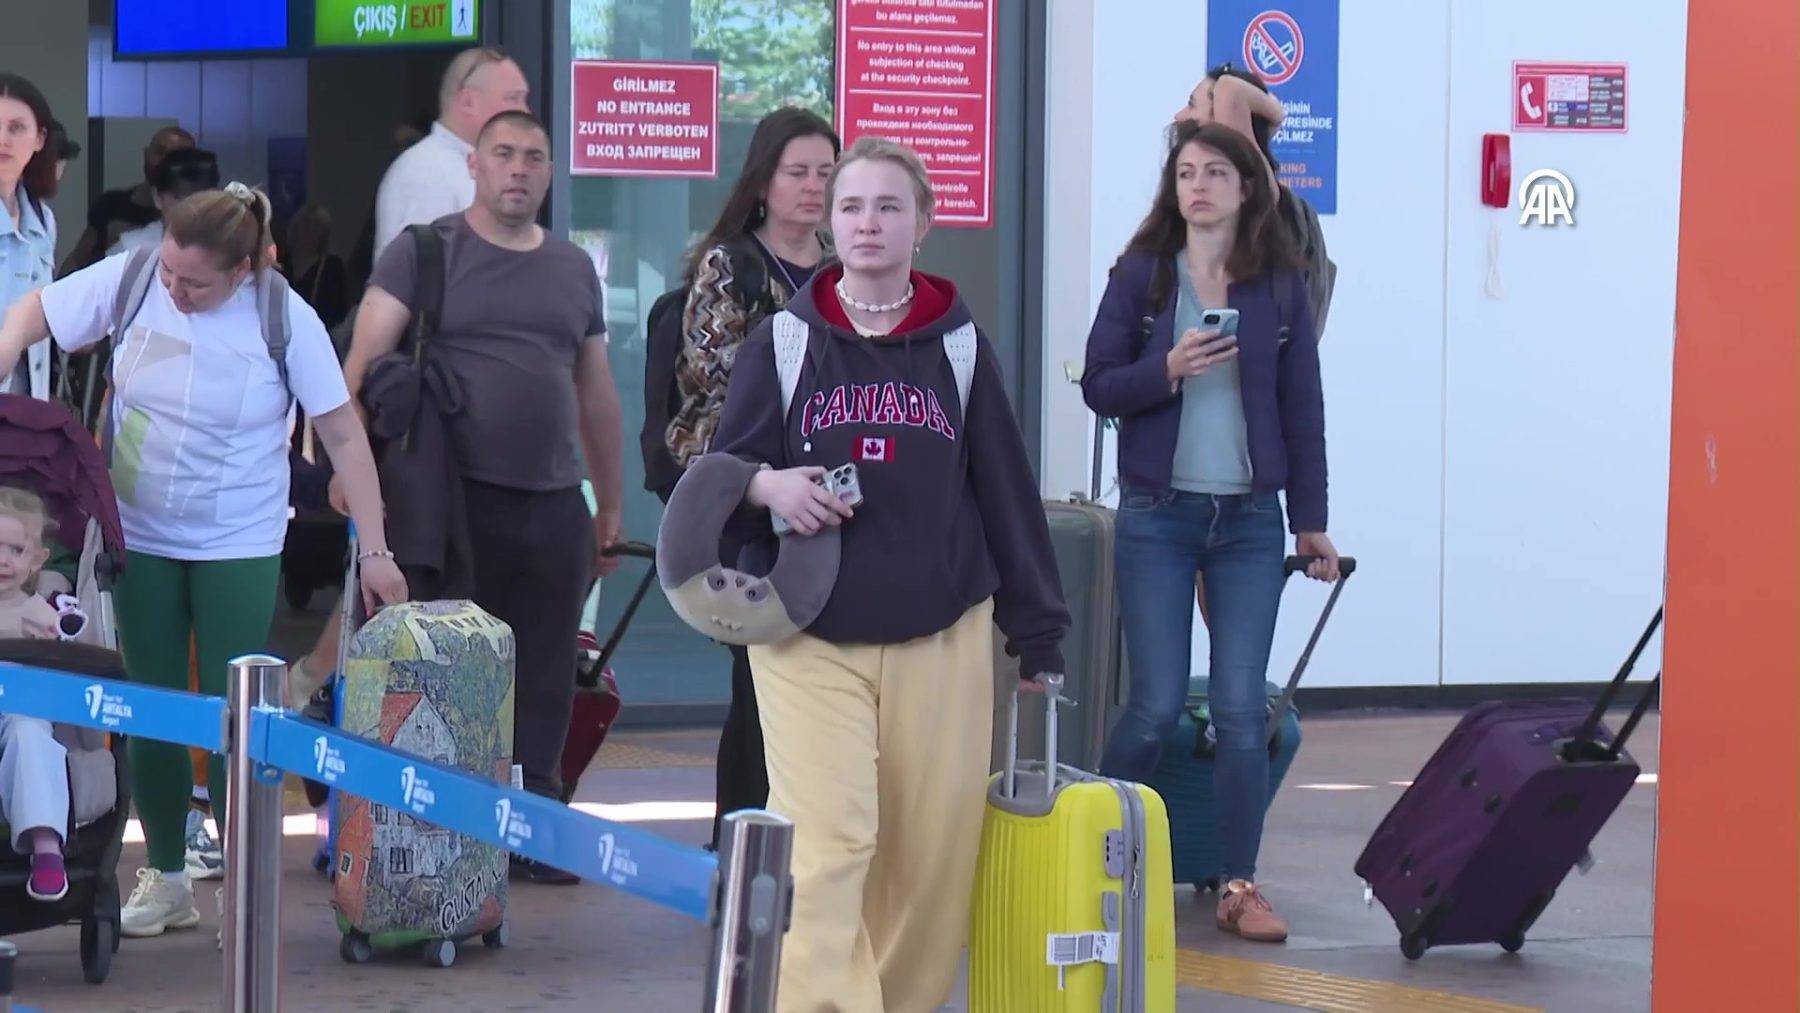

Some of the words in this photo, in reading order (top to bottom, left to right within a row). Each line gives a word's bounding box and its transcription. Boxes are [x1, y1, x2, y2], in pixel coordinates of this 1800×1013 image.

[354, 4, 397, 38] ÇIKIŞ
[410, 4, 446, 30] EXIT
[876, 10, 887, 21] bu
[889, 11, 912, 22] alana
[857, 40, 871, 50] No
[872, 41, 894, 53] entry
[895, 42, 905, 51] to
[906, 43, 922, 53] this
[924, 44, 943, 54] area
[944, 45, 976, 56] without
[869, 57, 914, 69] subjection
[915, 58, 925, 68] of
[925, 59, 964, 72] checking
[613, 76, 676, 93] GİRİLMEZ
[860, 73, 870, 82] at
[871, 73, 885, 82] the
[887, 74, 921, 85] security
[922, 75, 971, 86] checkpoint.
[597, 100, 617, 114] NO
[620, 102, 691, 116] ENTRANCE
[873, 103, 895, 115] Вход
[943, 105, 959, 116] без
[578, 121, 635, 136] ZUTRITT
[639, 123, 708, 138] VERBOTEN
[1281, 116, 1333, 129] VRESİNDE
[587, 144, 624, 160] ВХОД
[628, 145, 701, 162] ЗАПРЕЩЕН
[1280, 163, 1307, 174] KING
[801, 381, 955, 439] CANADA
